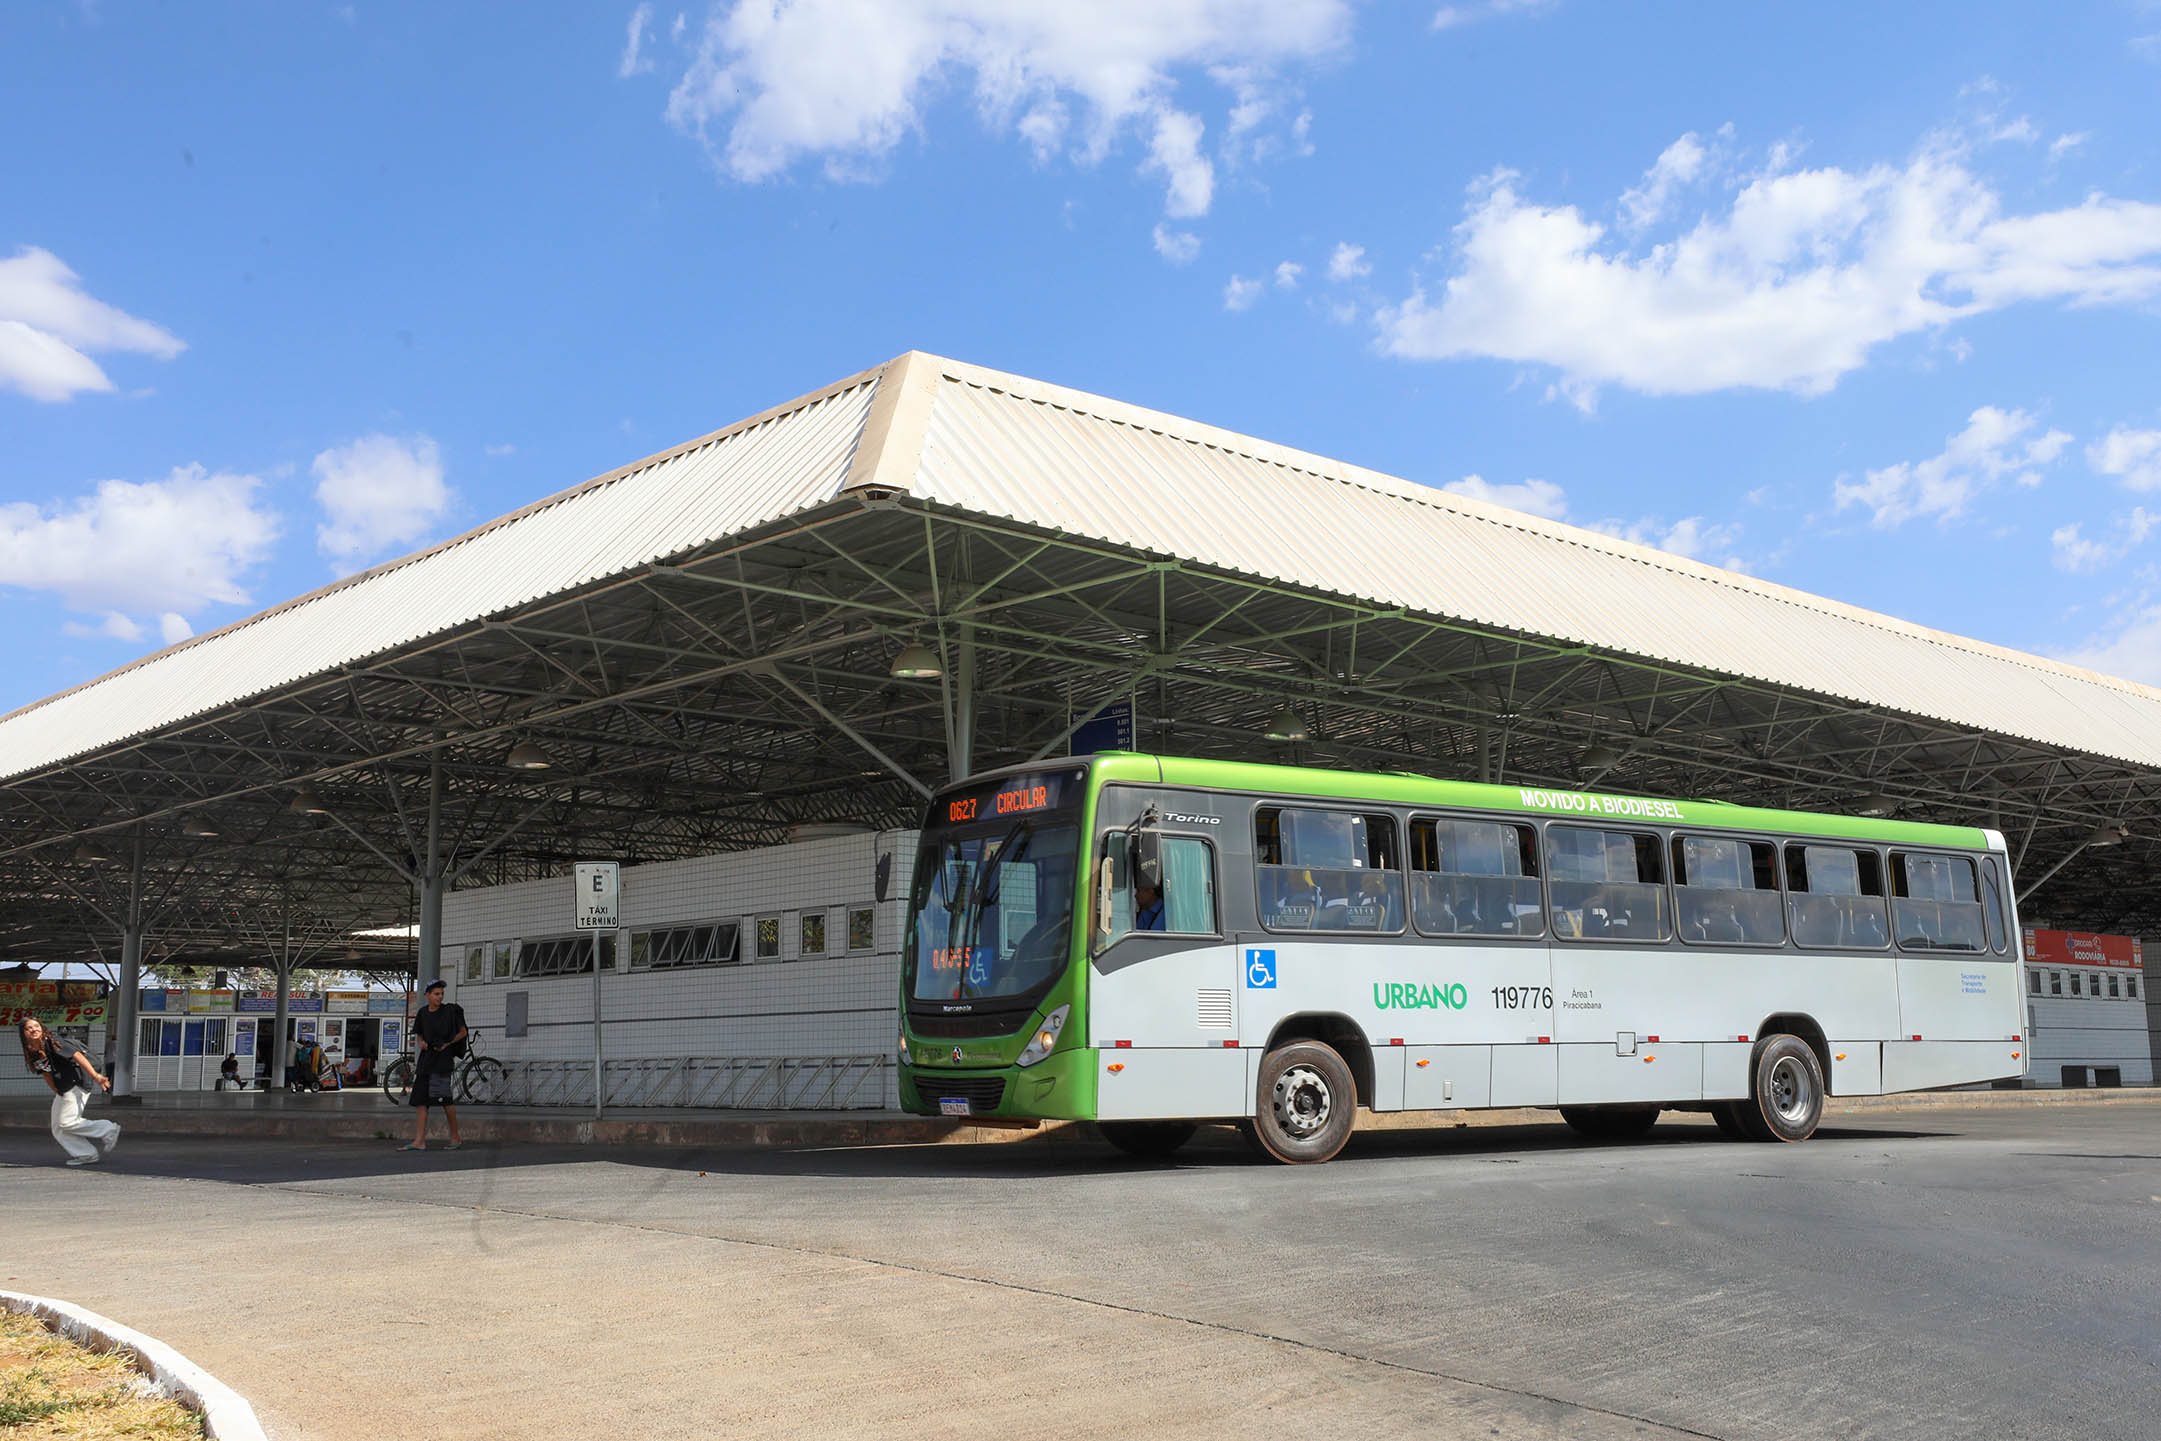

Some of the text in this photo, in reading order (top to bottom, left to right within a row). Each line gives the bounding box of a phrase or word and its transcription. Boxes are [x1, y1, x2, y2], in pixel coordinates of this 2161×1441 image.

[949, 785, 1047, 821] 0627 CIRCULAR
[1519, 789, 1684, 819] MOVIDO A BIODIESEL
[1164, 812, 1221, 825] Torino
[592, 875, 604, 892] E
[1373, 983, 1468, 1010] URBANO
[1490, 986, 1553, 1009] 119776
[1589, 989, 1593, 998] 1
